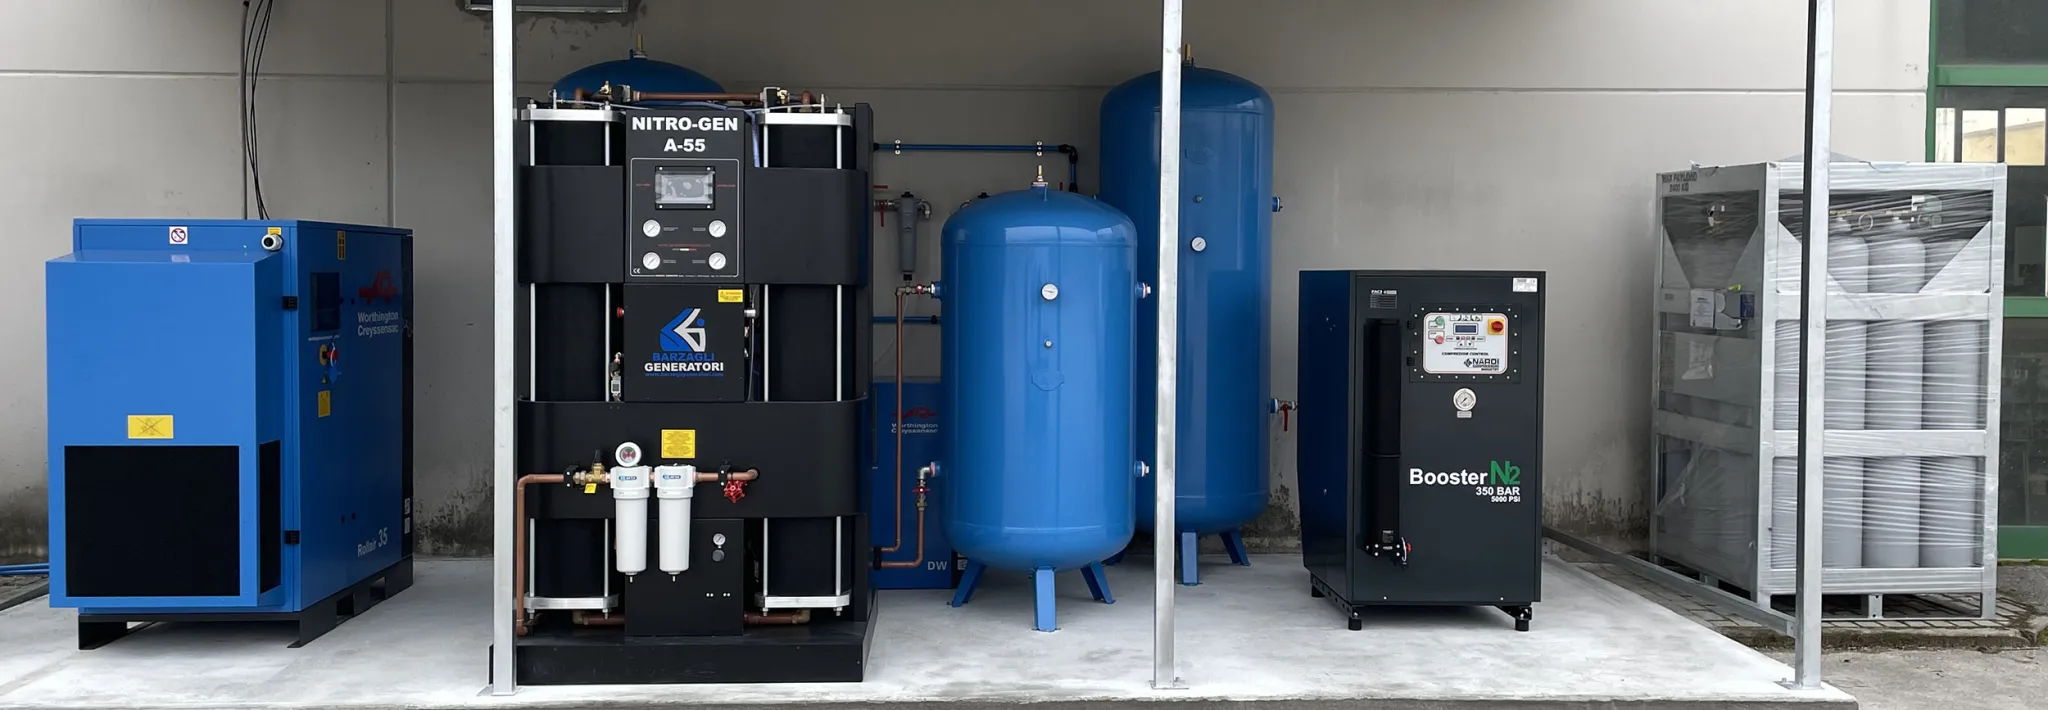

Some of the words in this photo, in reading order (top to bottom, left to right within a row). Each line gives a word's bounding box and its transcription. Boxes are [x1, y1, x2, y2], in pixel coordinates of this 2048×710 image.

[632, 116, 738, 131] NITRO-GEN
[663, 138, 706, 152] A-55
[1673, 171, 1697, 182] PAYLOAD
[357, 310, 399, 324] Worthington
[357, 324, 399, 338] Creyssensac
[652, 352, 715, 361] BARZAGLI
[644, 362, 724, 372] GENERATORI
[1409, 468, 1488, 485] Booster
[1475, 486, 1494, 496] 350
[1496, 486, 1520, 495] BAR
[1491, 495, 1507, 503] 5000
[378, 527, 388, 548] 35
[927, 560, 947, 570] DW
